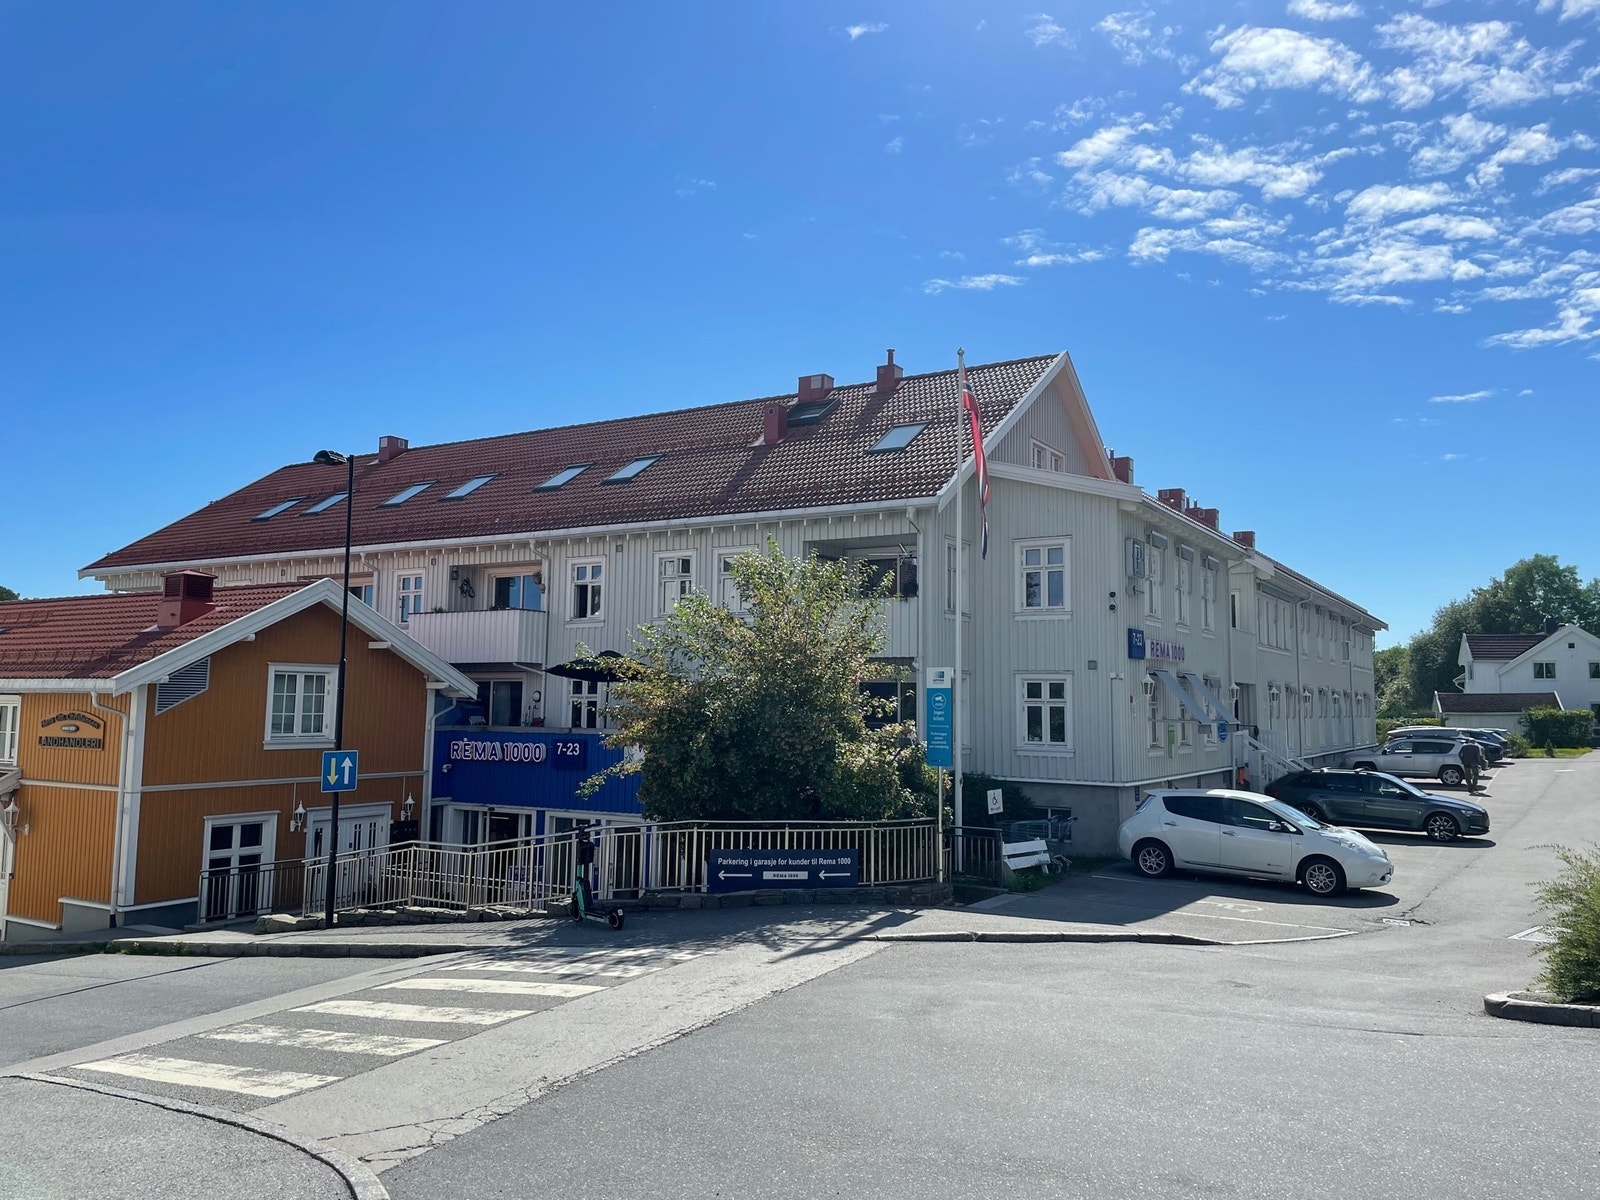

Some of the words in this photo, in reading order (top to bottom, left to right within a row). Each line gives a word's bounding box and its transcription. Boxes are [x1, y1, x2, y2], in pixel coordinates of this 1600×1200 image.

[1132, 632, 1143, 646] 7-23
[1150, 641, 1170, 659] REMA
[450, 741, 502, 761] REMA
[504, 743, 546, 762] 1000
[556, 743, 580, 755] 7-23
[717, 857, 749, 867] Parkering
[753, 858, 777, 867] garasje
[778, 857, 787, 865] for
[837, 857, 851, 865] 1000
